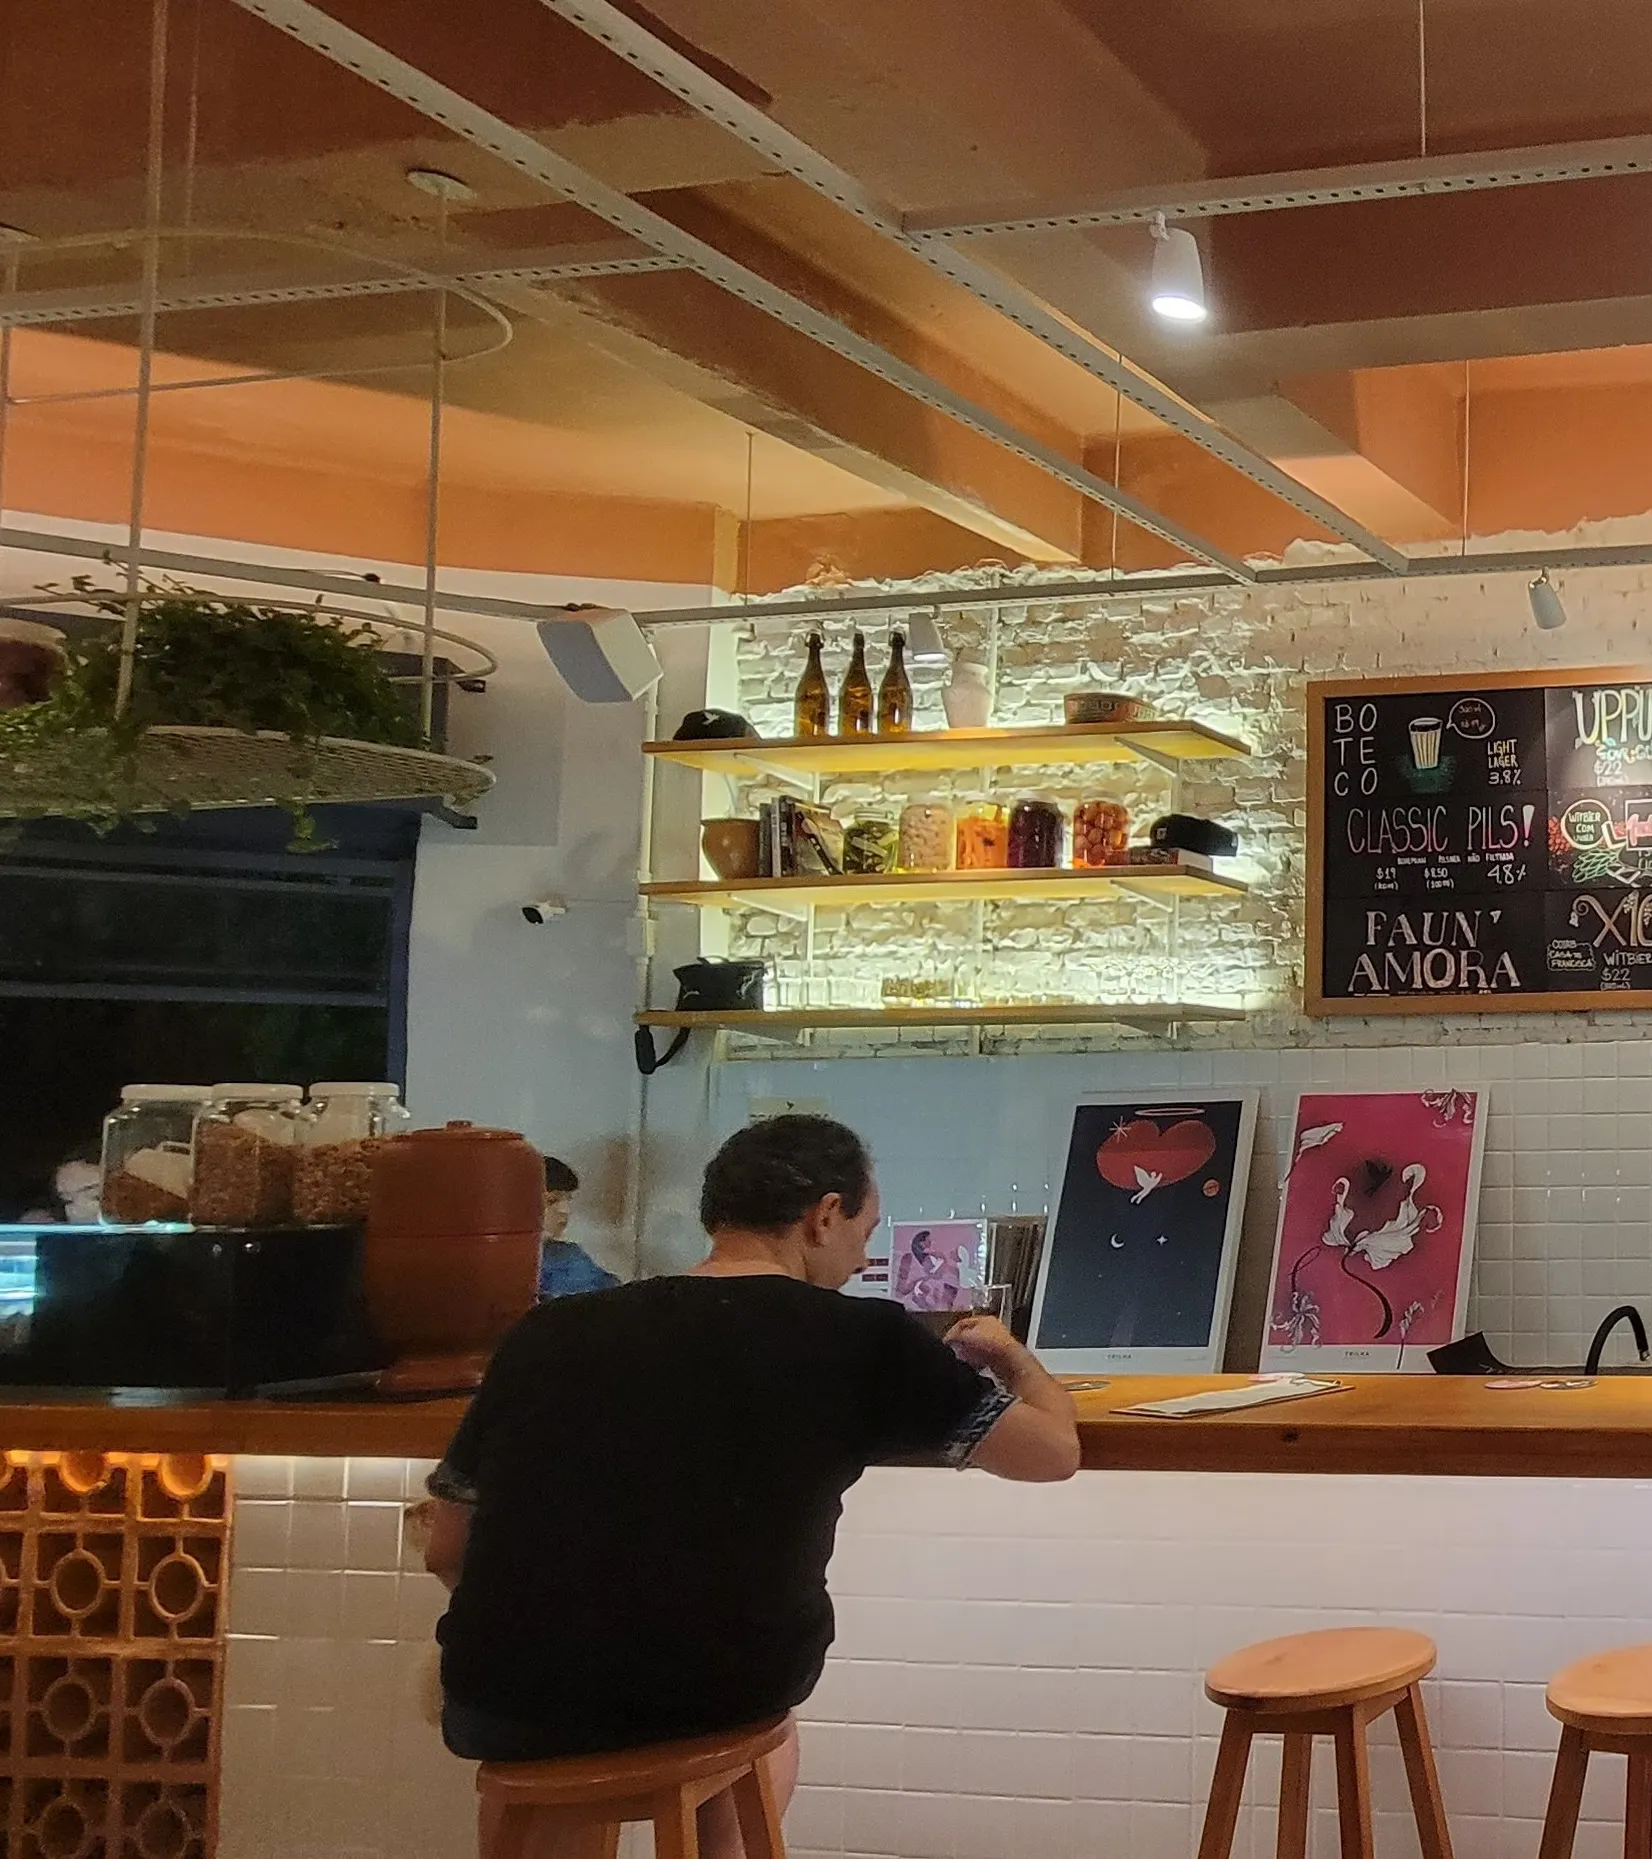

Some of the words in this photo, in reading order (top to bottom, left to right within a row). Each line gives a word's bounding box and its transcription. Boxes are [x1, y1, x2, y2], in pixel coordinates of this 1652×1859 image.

[1487, 739, 1518, 756] LIGHT
[1488, 754, 1519, 769] LAGER
[1346, 805, 1449, 854] CLASSIC
[1467, 804, 1535, 850] PILS!
[1348, 948, 1521, 992] AMORA
[1600, 967, 1631, 981] $22
